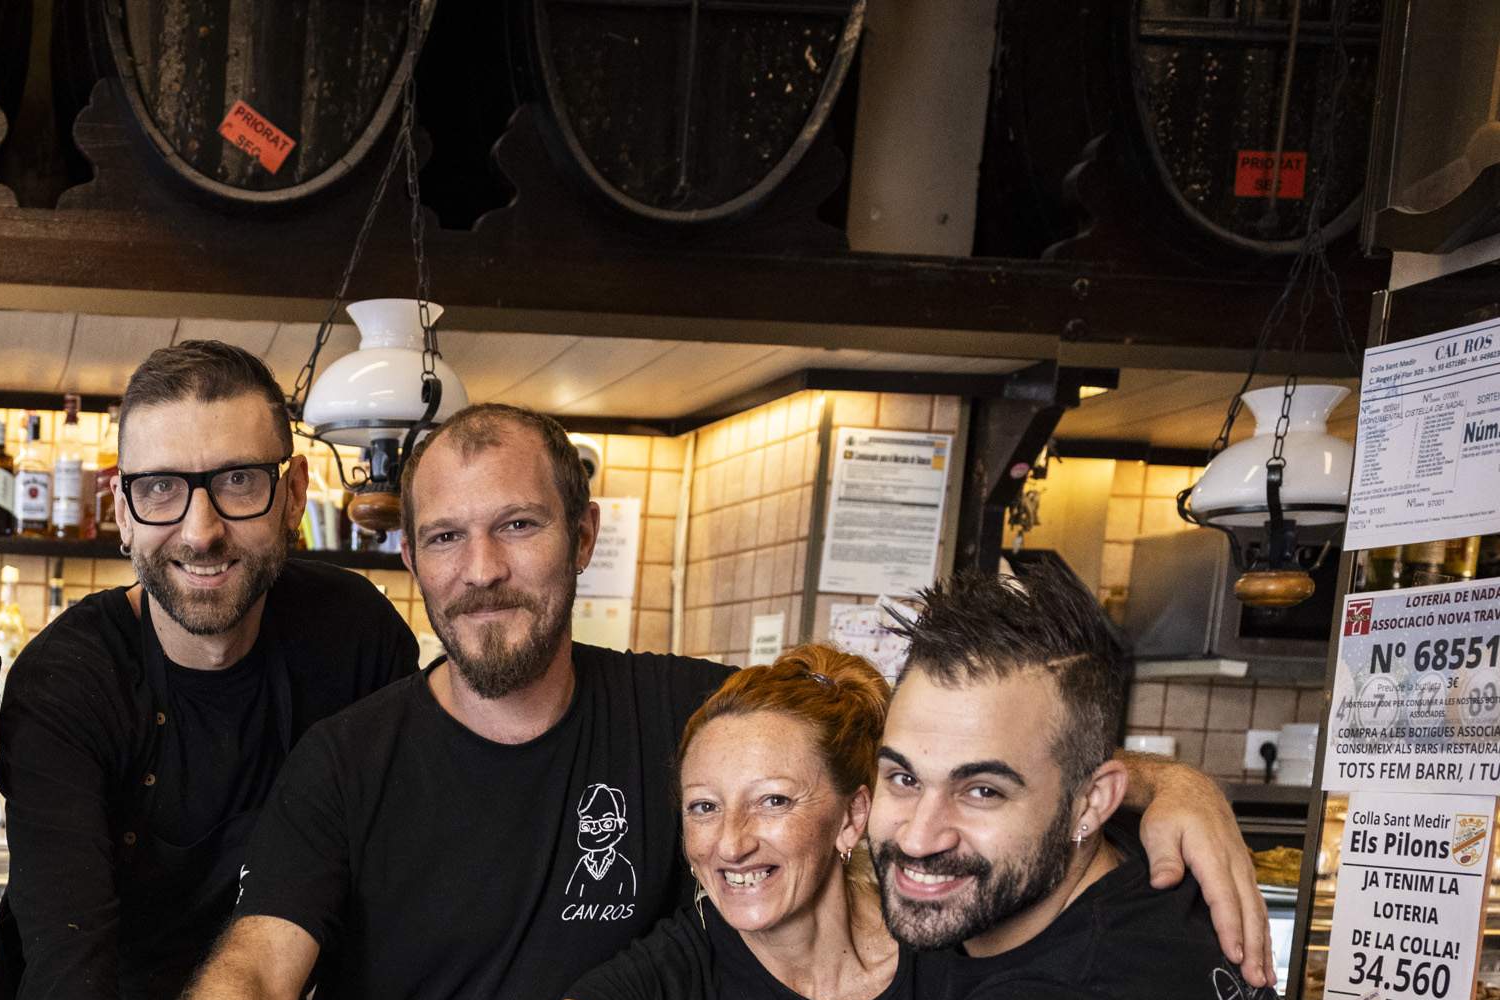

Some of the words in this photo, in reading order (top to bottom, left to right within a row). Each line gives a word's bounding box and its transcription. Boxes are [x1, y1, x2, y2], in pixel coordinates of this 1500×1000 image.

[235, 106, 289, 152] PRIORAT
[1435, 342, 1459, 360] CAL
[1463, 334, 1493, 354] ROS
[1406, 593, 1451, 608] LOTERIA
[1454, 590, 1469, 603] DE
[1371, 612, 1435, 631] ASSOCIACIÓ
[1438, 610, 1471, 626] NOVA
[1414, 634, 1500, 672] 68551
[1338, 727, 1378, 738] COMPRA
[1380, 727, 1387, 738] A
[1390, 727, 1406, 738] LES
[1408, 726, 1455, 738] BOTIGUES
[1336, 743, 1393, 754] CONSUMEIX
[1395, 743, 1412, 754] ALS
[1415, 743, 1438, 754] BARS
[1338, 762, 1375, 779] TOTS
[1380, 762, 1411, 780] FEM
[1415, 763, 1464, 783] BARRI,
[1469, 763, 1475, 780] I
[1352, 811, 1380, 826] Colla
[1383, 812, 1410, 827] Sant
[1414, 814, 1451, 829] Medir
[1350, 830, 1378, 854] Els
[1384, 831, 1450, 859] Pilons
[1361, 870, 1380, 891] JA
[1384, 872, 1434, 893] TENIM
[1438, 877, 1460, 896] LA
[561, 904, 600, 921] CAN
[599, 904, 636, 921] ROS
[1373, 901, 1439, 925] LOTERIA
[1351, 929, 1371, 947] DE
[1375, 932, 1395, 951] LA
[1400, 935, 1461, 960] COLLA!
[1349, 952, 1450, 999] 34.560
